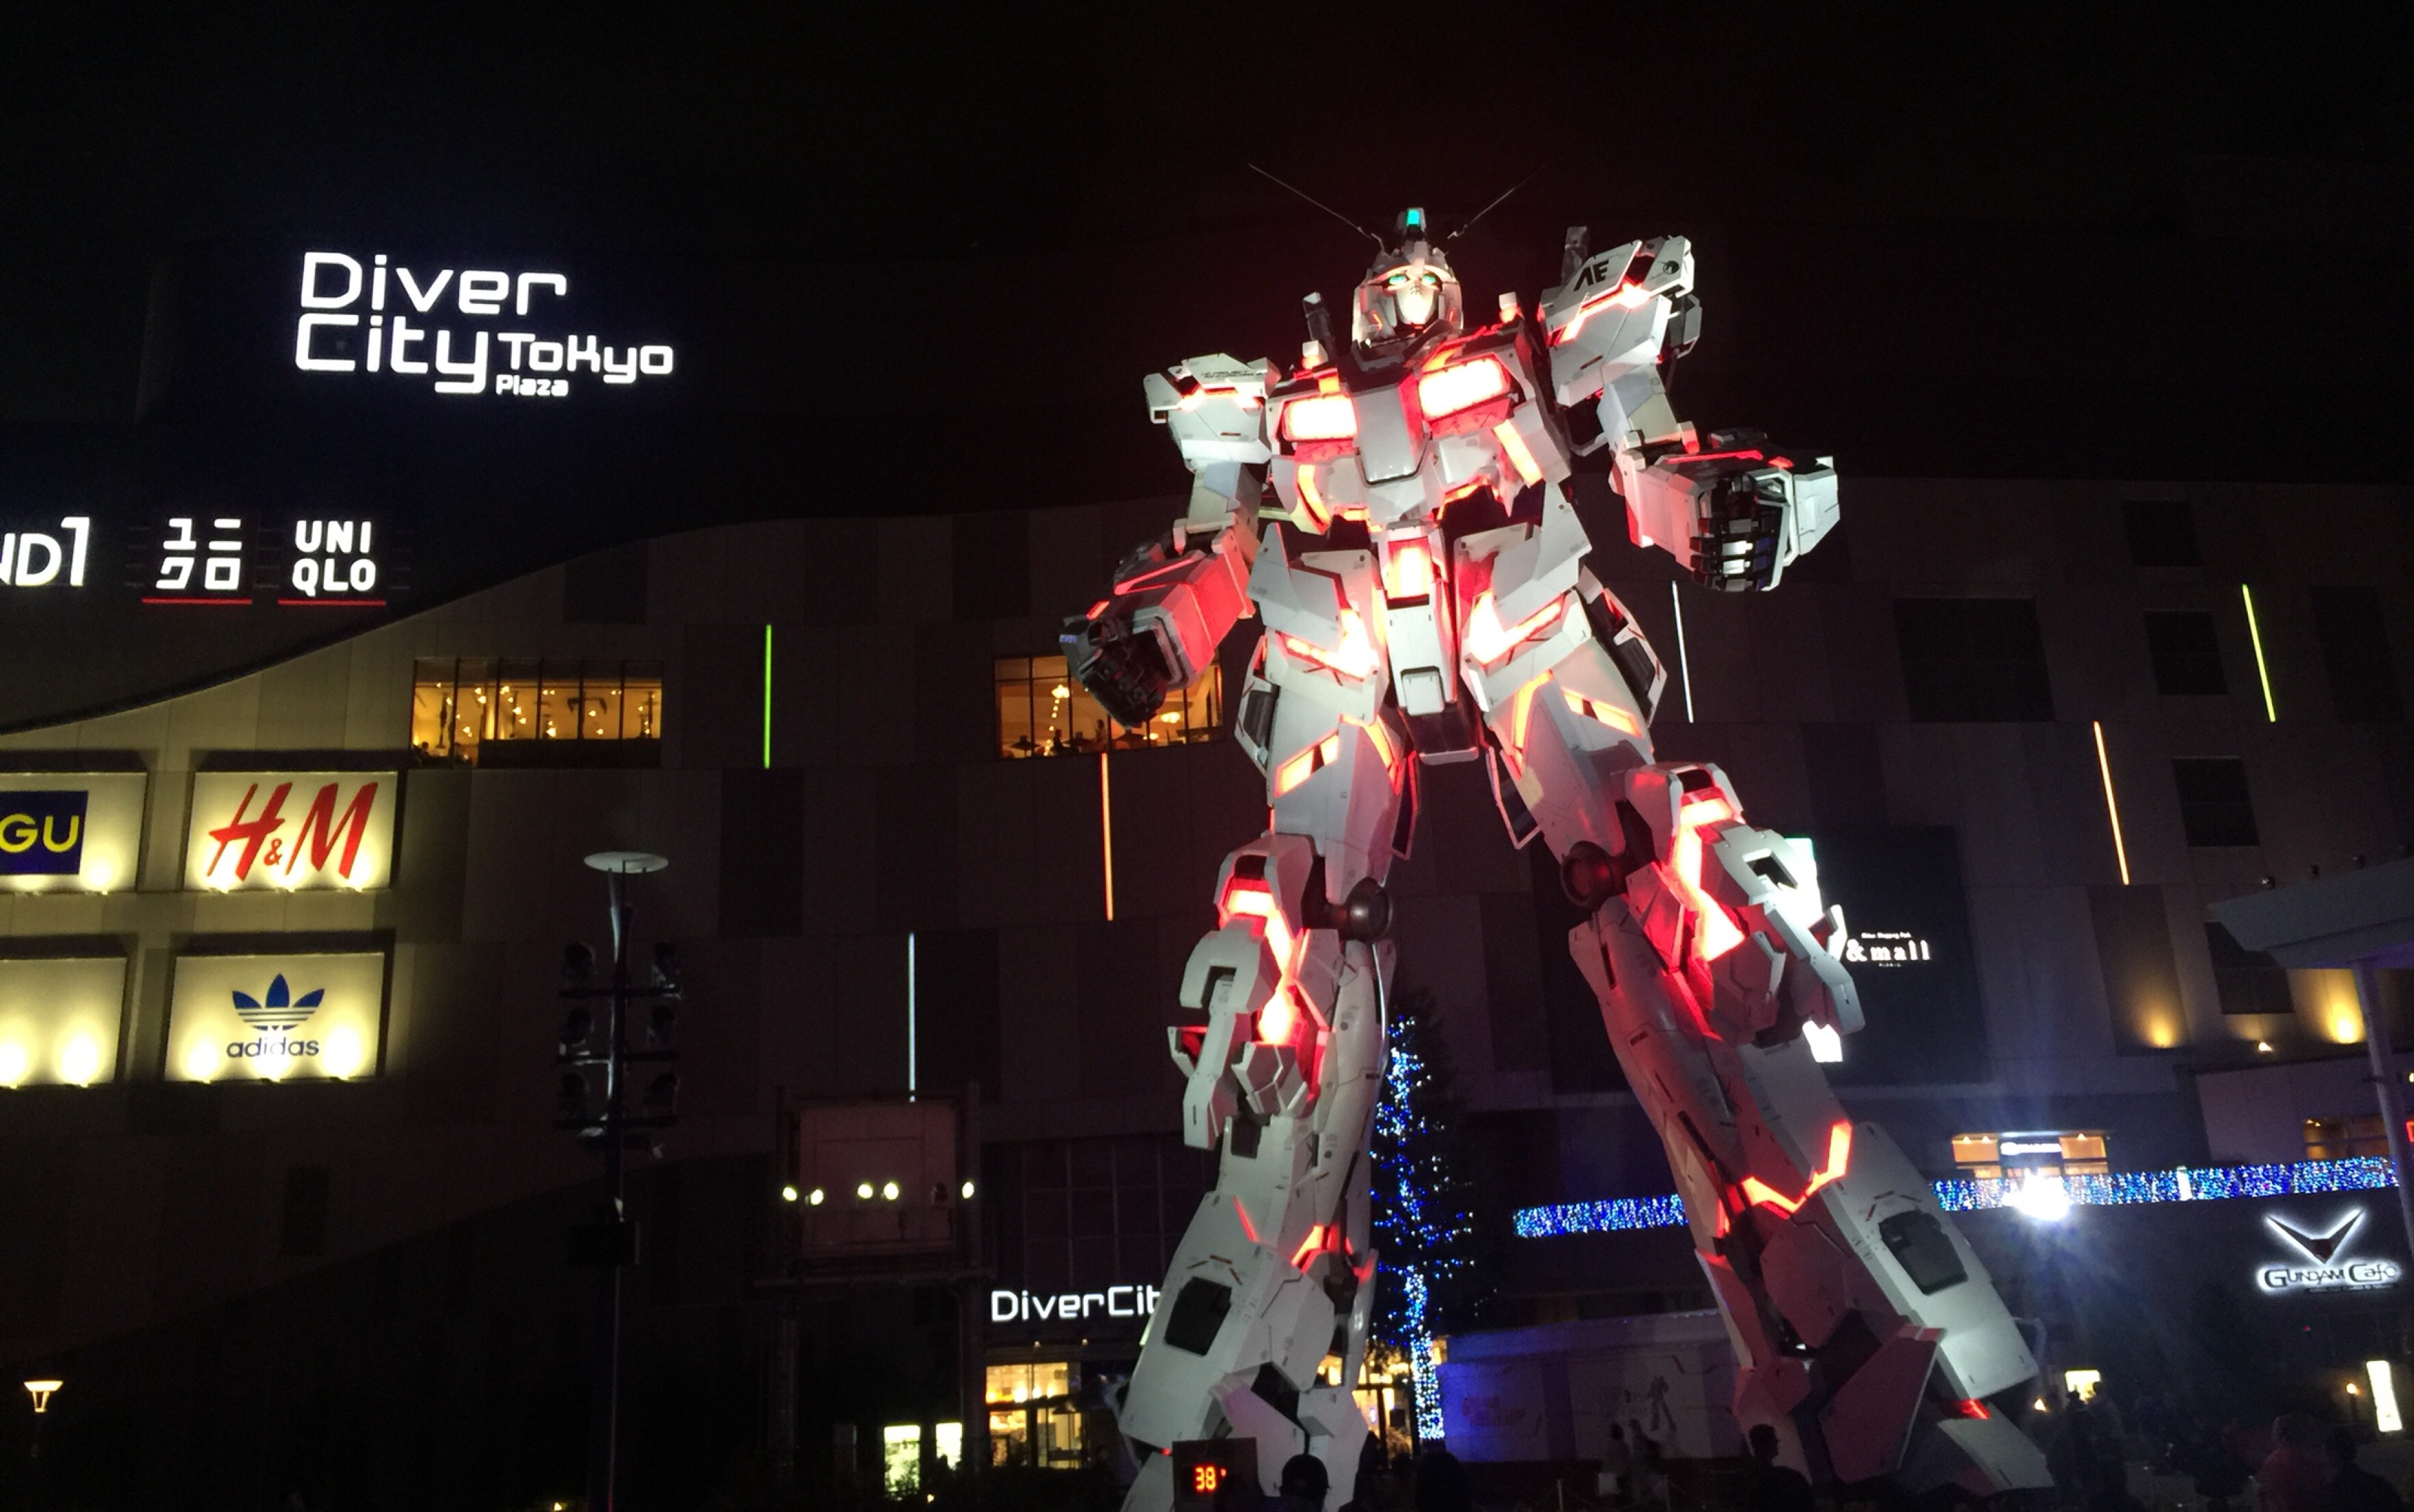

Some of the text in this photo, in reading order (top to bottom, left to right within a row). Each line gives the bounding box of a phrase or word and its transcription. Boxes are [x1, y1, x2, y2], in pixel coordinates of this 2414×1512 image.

[301, 251, 567, 315] Diver
[296, 313, 488, 394] City
[495, 374, 569, 397] Plaza
[294, 520, 372, 554] UNI
[292, 558, 376, 596] QLO
[0, 814, 79, 853] GU
[208, 782, 379, 881] H&M
[1870, 939, 1930, 961] mall
[226, 1037, 320, 1058] adidas
